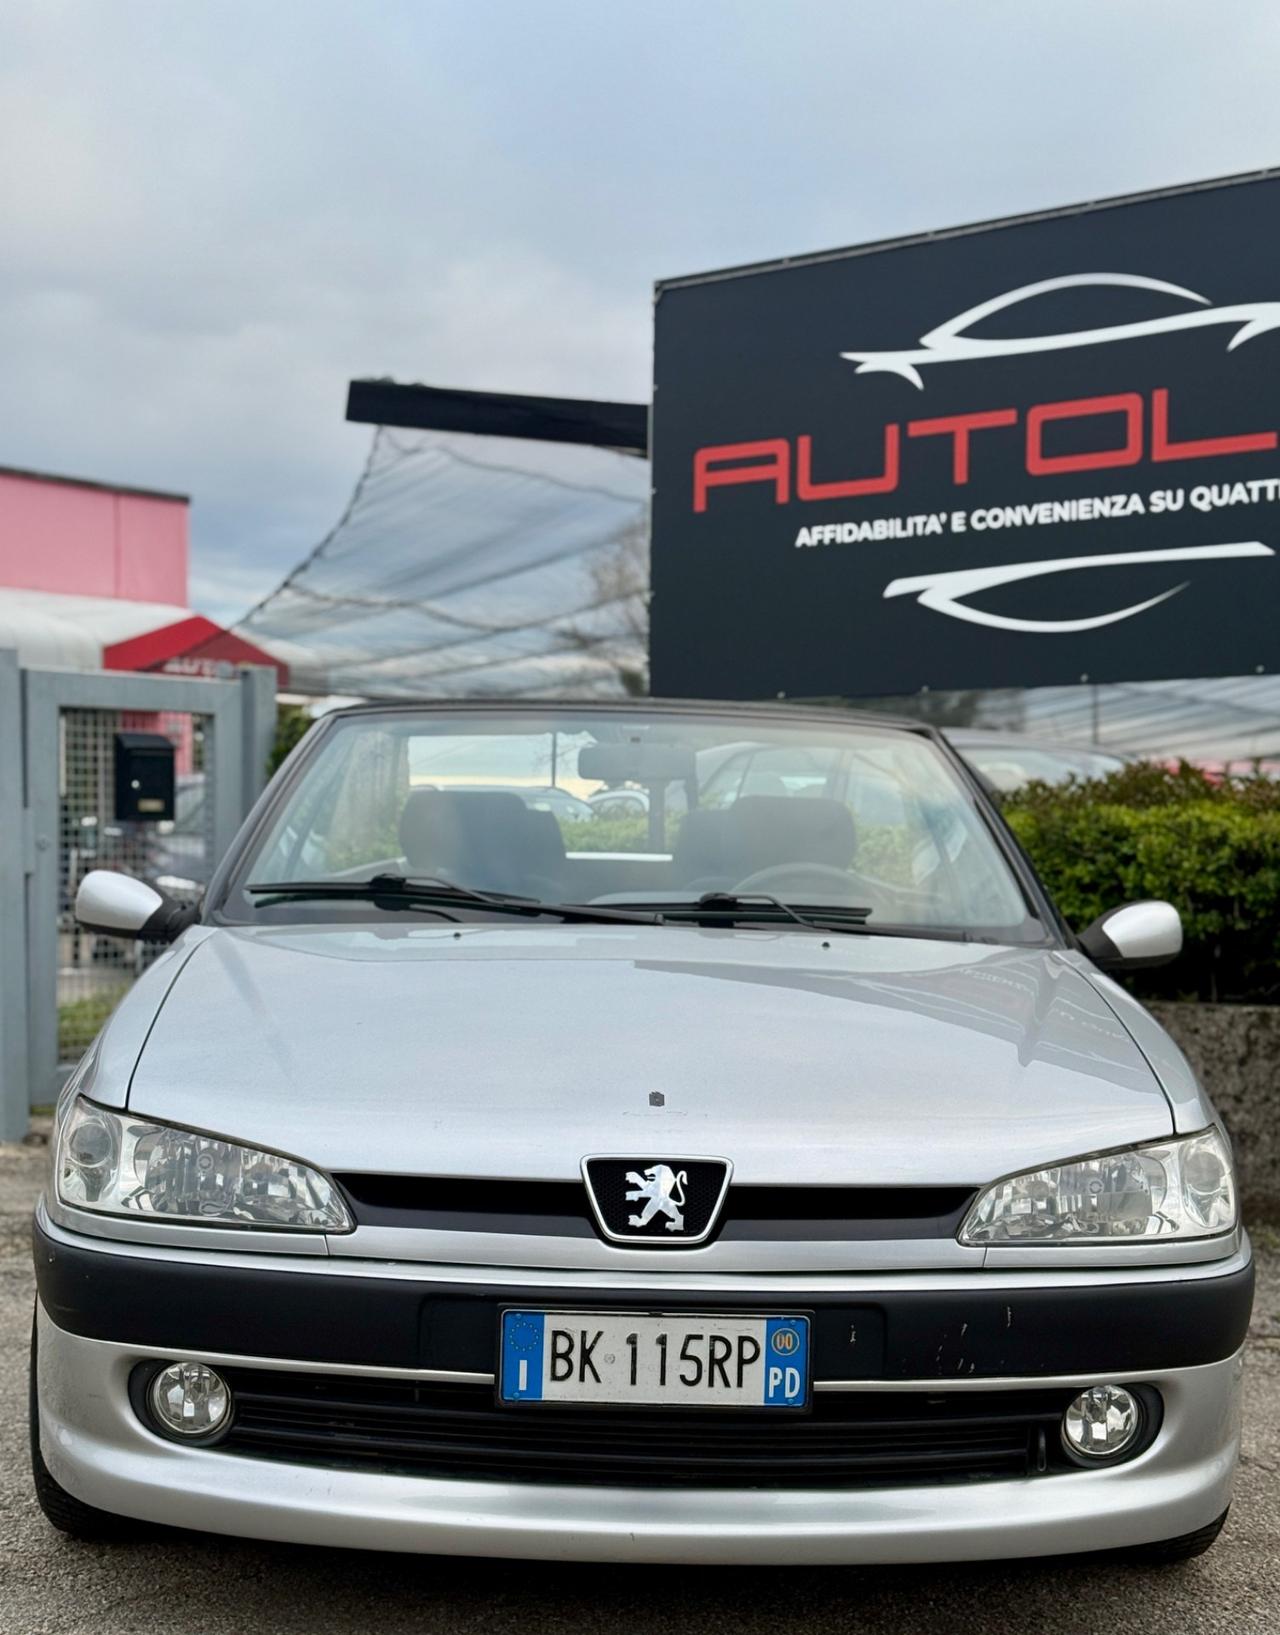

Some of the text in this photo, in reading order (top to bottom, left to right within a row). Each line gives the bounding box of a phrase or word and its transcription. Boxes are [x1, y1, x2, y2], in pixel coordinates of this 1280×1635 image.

[795, 478, 1280, 548] AFFIDABILITA' E CONVENIENZA SU QUATT
[518, 1329, 801, 1398] I BK 115RP PD
